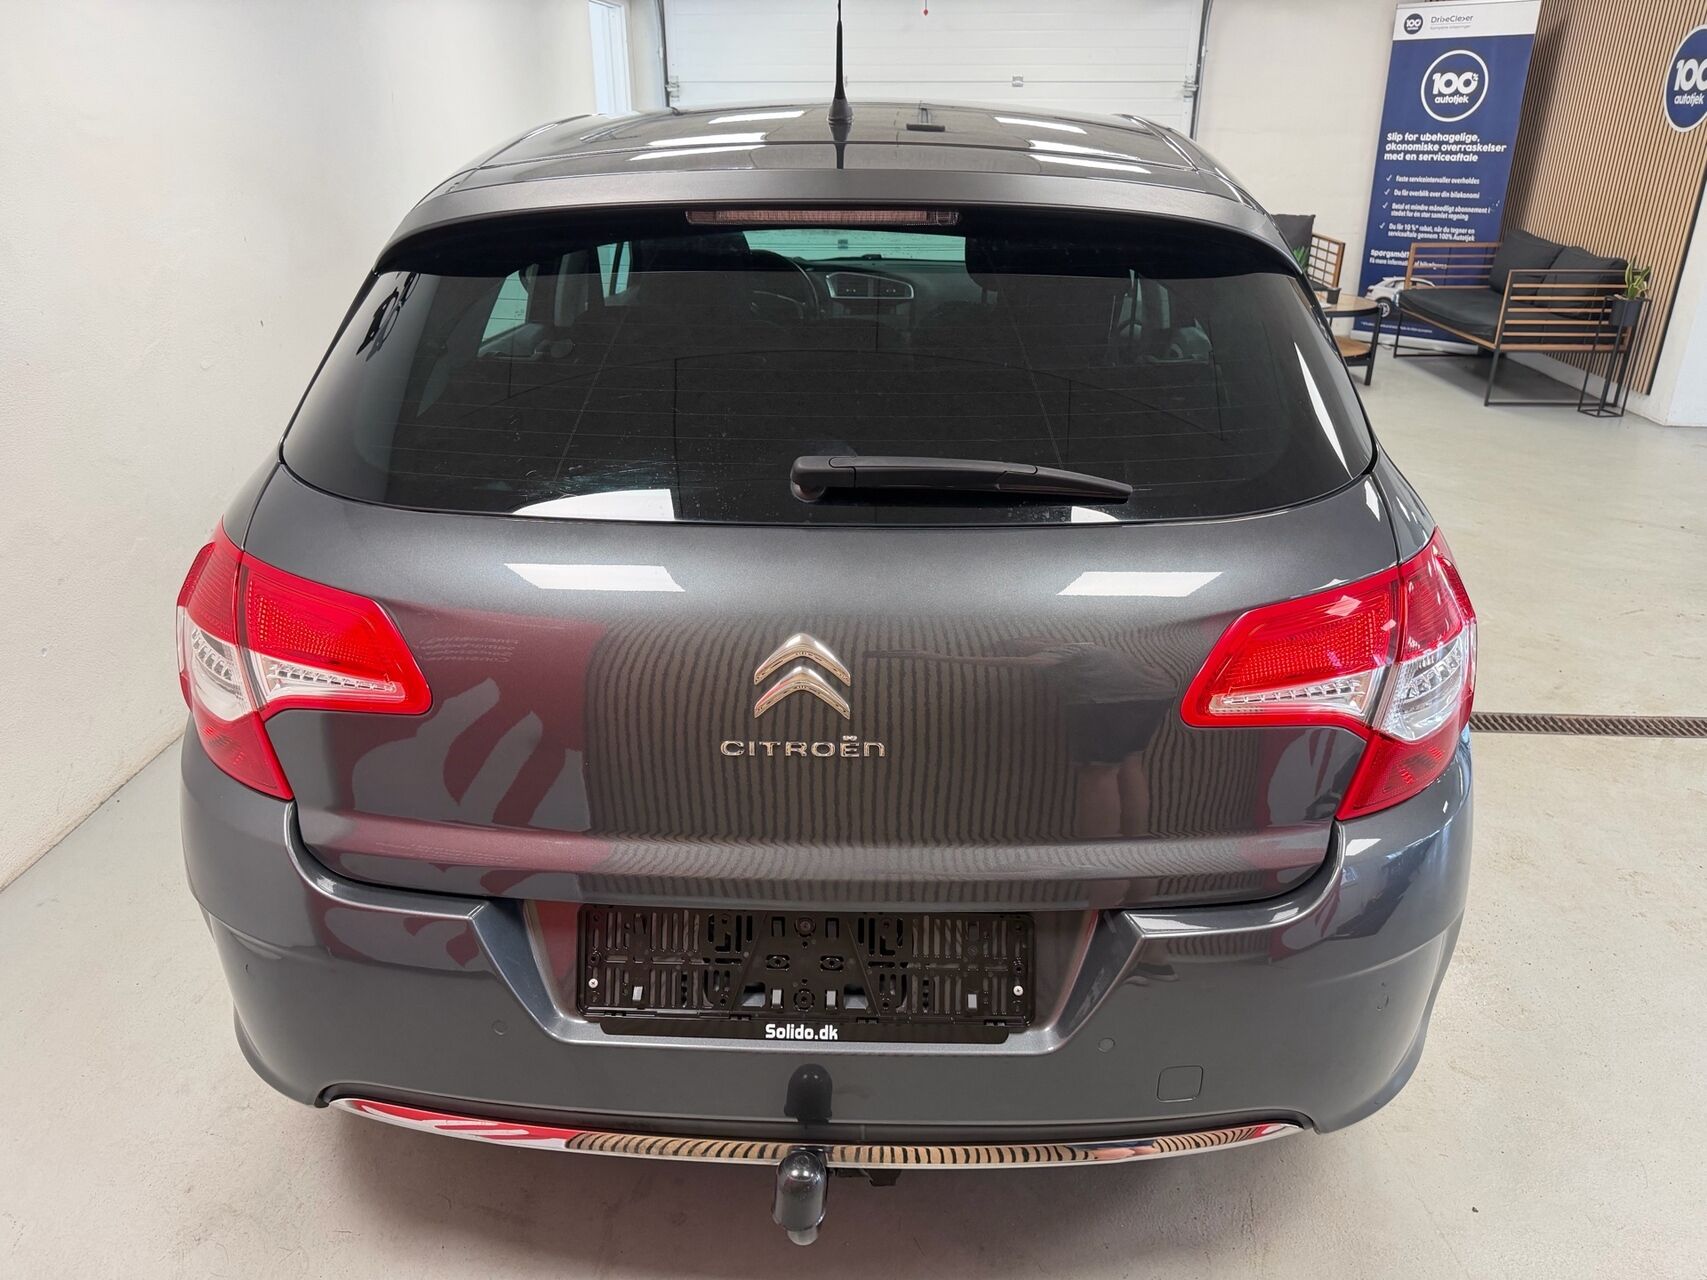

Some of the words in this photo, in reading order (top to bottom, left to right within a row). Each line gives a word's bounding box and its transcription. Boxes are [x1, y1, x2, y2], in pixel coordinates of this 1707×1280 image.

[1434, 94, 1469, 104] autotjek
[1674, 92, 1705, 107] autotjek
[1386, 132, 1402, 142] Slip
[1404, 132, 1419, 141] for
[1420, 132, 1480, 143] ubehagelige,
[1385, 142, 1439, 151] økonomiske
[1441, 143, 1507, 152] overraskelser
[1384, 152, 1403, 160] med
[1405, 153, 1417, 161] en
[1418, 152, 1478, 162] serviceaftale
[765, 1024, 838, 1040] Solido.dk
